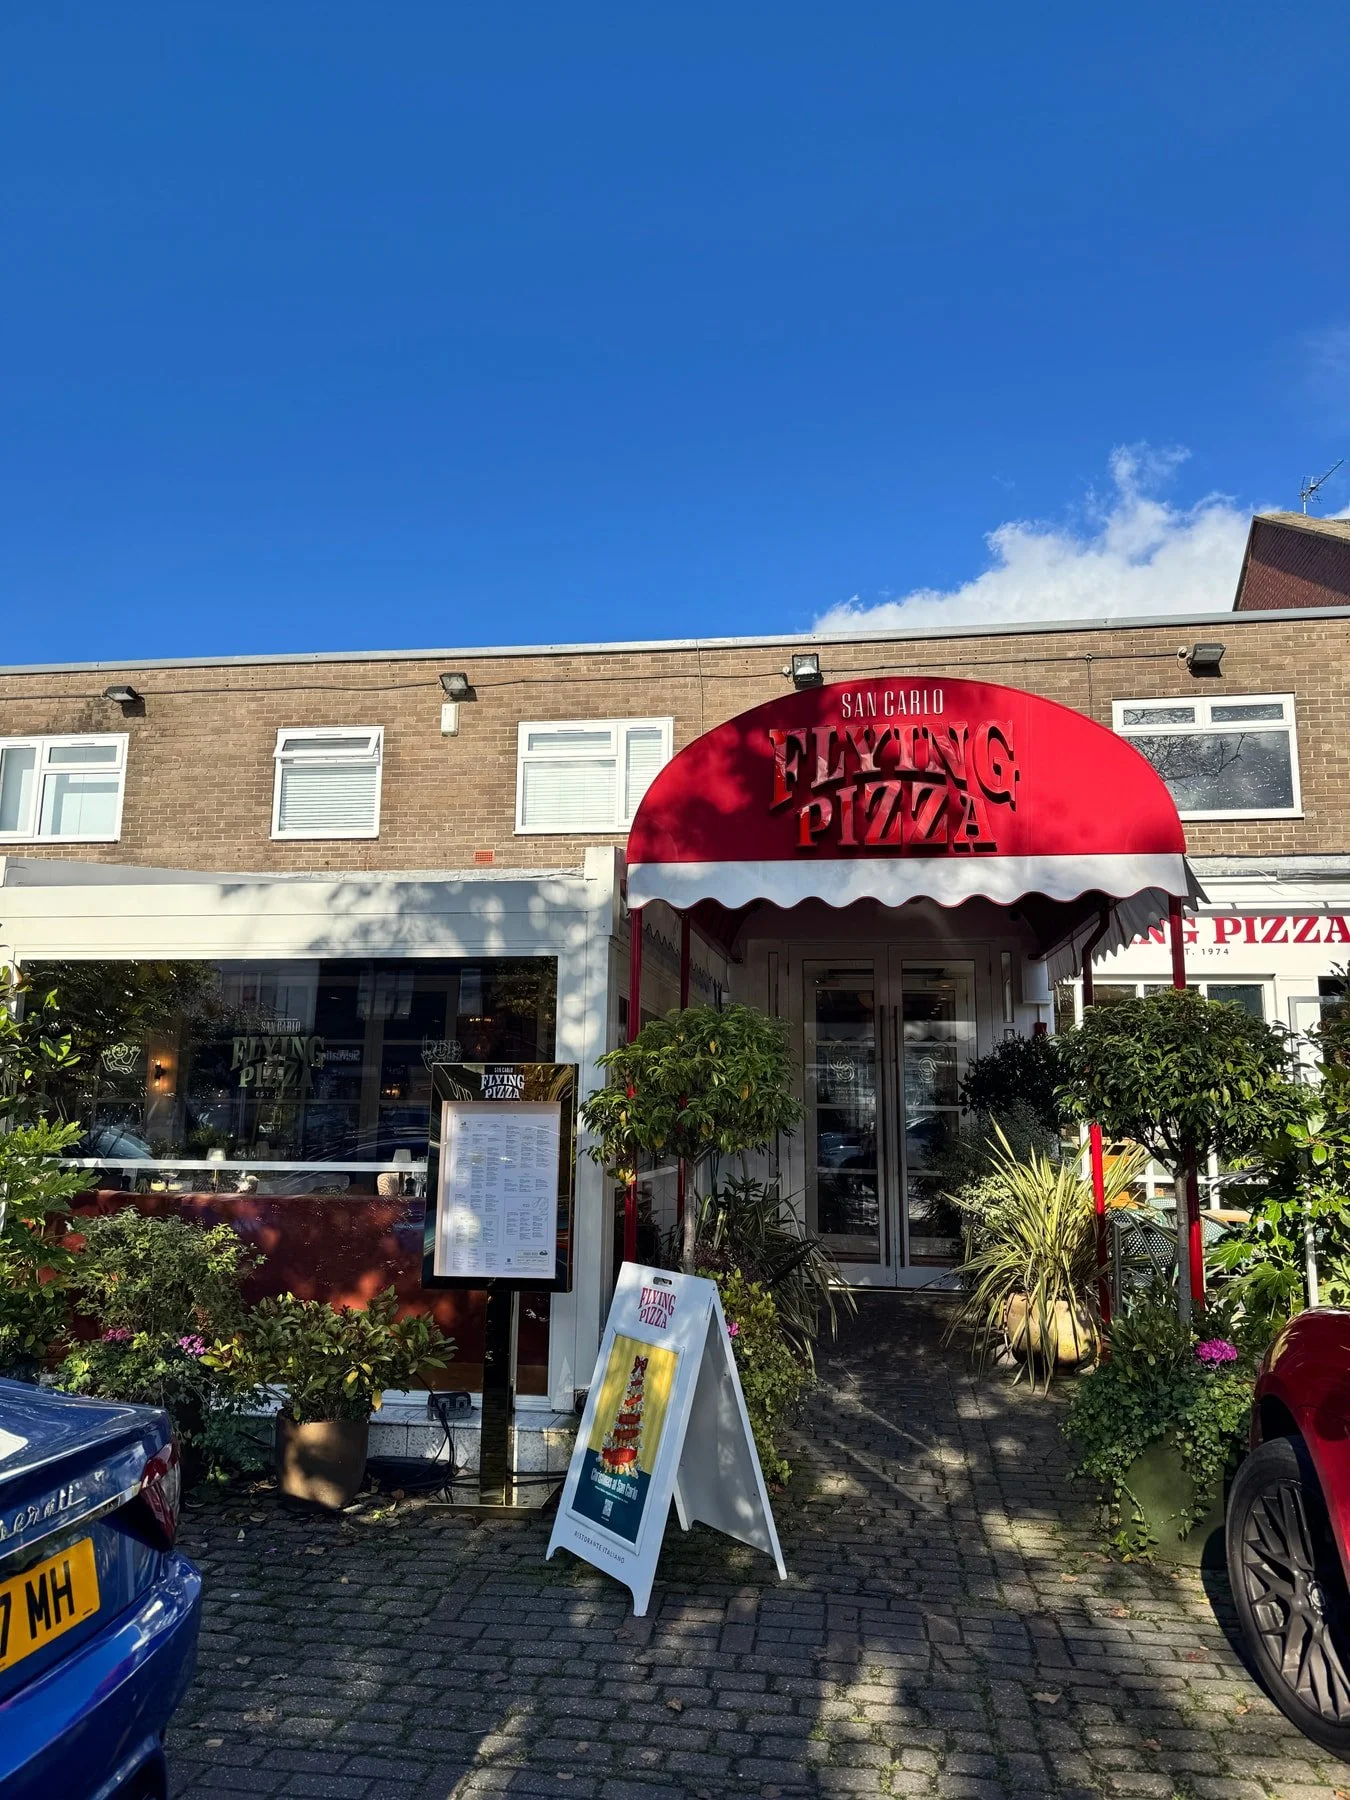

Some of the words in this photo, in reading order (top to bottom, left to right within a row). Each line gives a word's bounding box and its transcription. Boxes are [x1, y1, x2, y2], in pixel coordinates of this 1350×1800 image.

[842, 692, 877, 718] SAN
[884, 688, 944, 717] CARLO
[769, 719, 1019, 812] FLYING
[797, 780, 997, 853] PIZZA
[1212, 916, 1350, 944] PIZZA
[1201, 948, 1230, 956] 1974
[230, 1036, 325, 1070] FLYING
[238, 1060, 314, 1088] PIZZA
[480, 1074, 526, 1090] FLYING
[484, 1085, 521, 1099] PIZZA
[638, 1287, 676, 1318] FLYING
[639, 1306, 667, 1329] PIZZA
[574, 1531, 602, 1551] RISTORANTE
[602, 1546, 625, 1564] ITALIANO
[25, 1560, 75, 1640] MH
